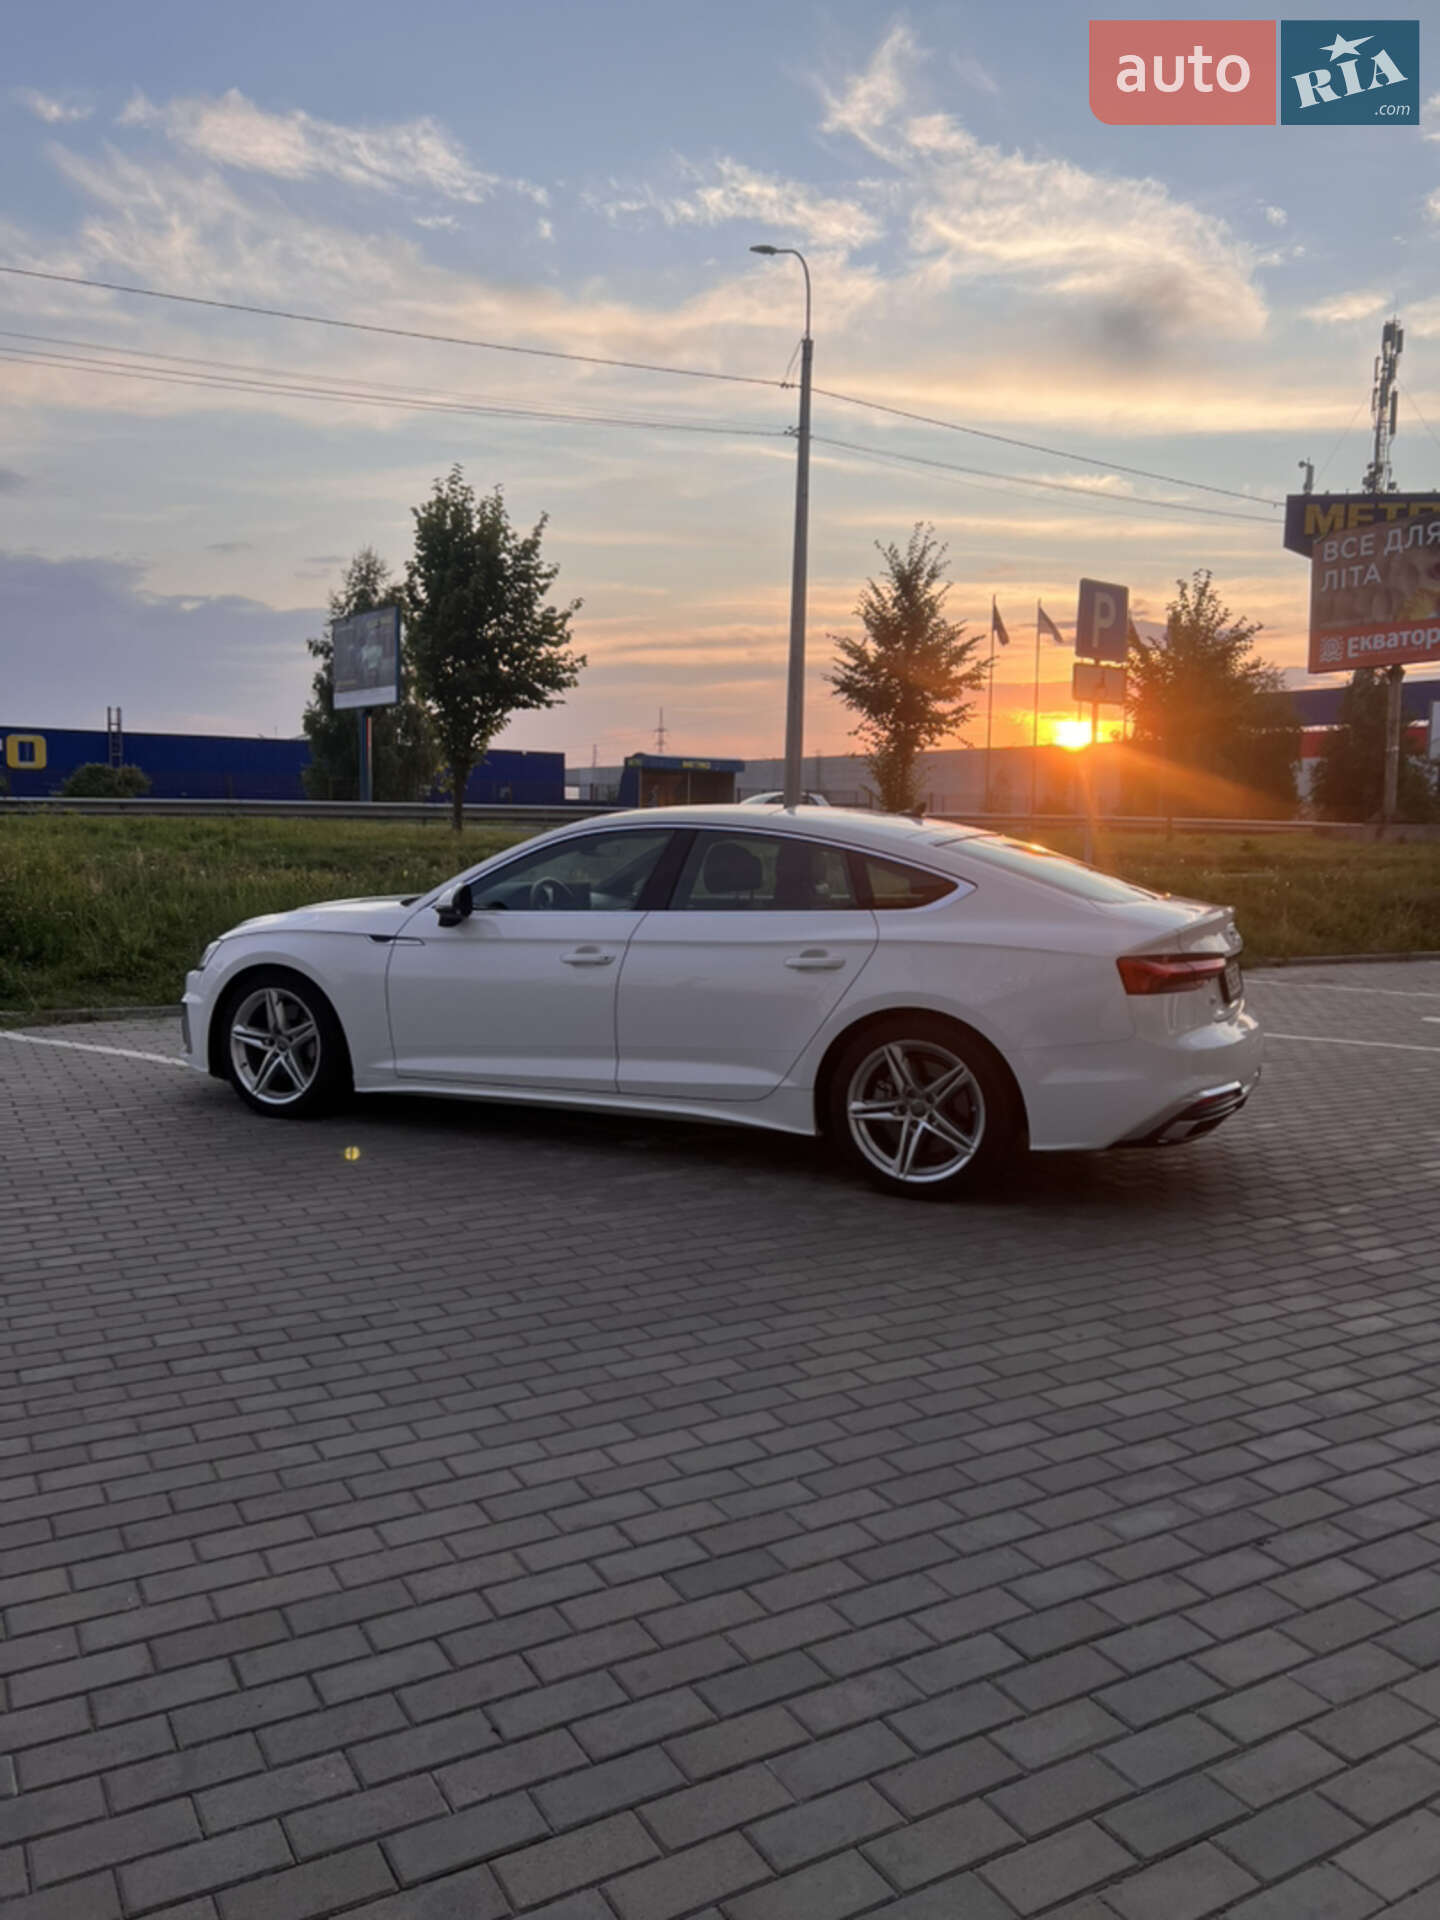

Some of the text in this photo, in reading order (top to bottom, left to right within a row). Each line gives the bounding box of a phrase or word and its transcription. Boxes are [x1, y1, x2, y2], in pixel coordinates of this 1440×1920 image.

[1322, 533, 1376, 562] ВСЕ
[1320, 563, 1382, 593] ЛІТА
[1092, 591, 1117, 649] P
